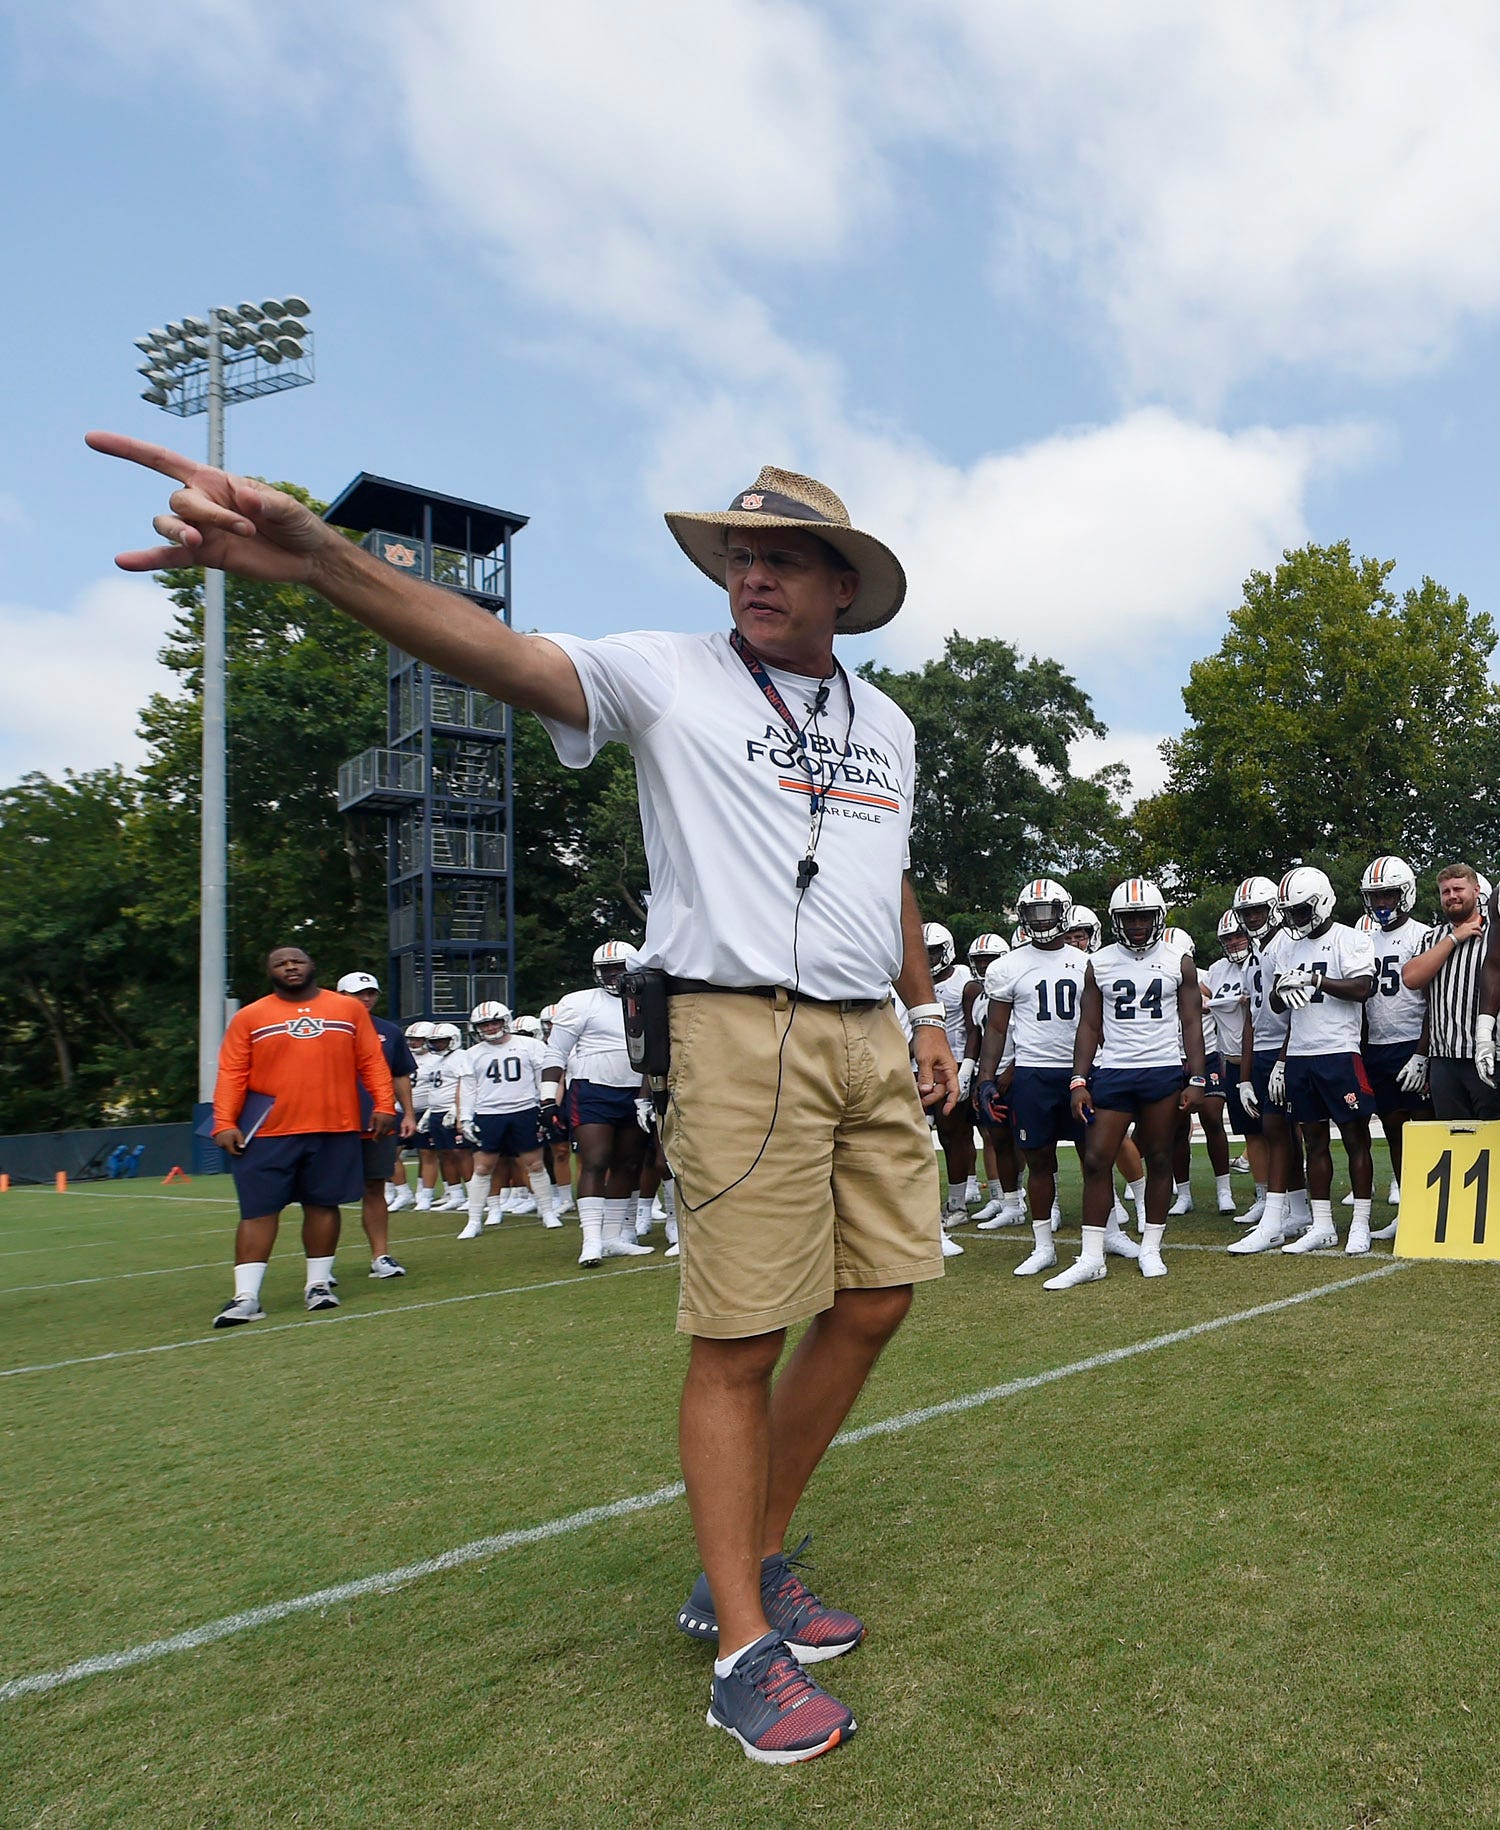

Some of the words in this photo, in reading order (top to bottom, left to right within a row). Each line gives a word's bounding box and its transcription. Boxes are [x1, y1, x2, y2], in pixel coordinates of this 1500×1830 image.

[764, 724, 891, 770] AUBURN
[746, 740, 906, 799] FOOTBALL
[842, 808, 882, 824] EAGLE
[1035, 979, 1078, 1021] 10
[1113, 978, 1164, 1020] 24
[486, 1056, 521, 1084] 40
[1427, 1149, 1490, 1243] 11
